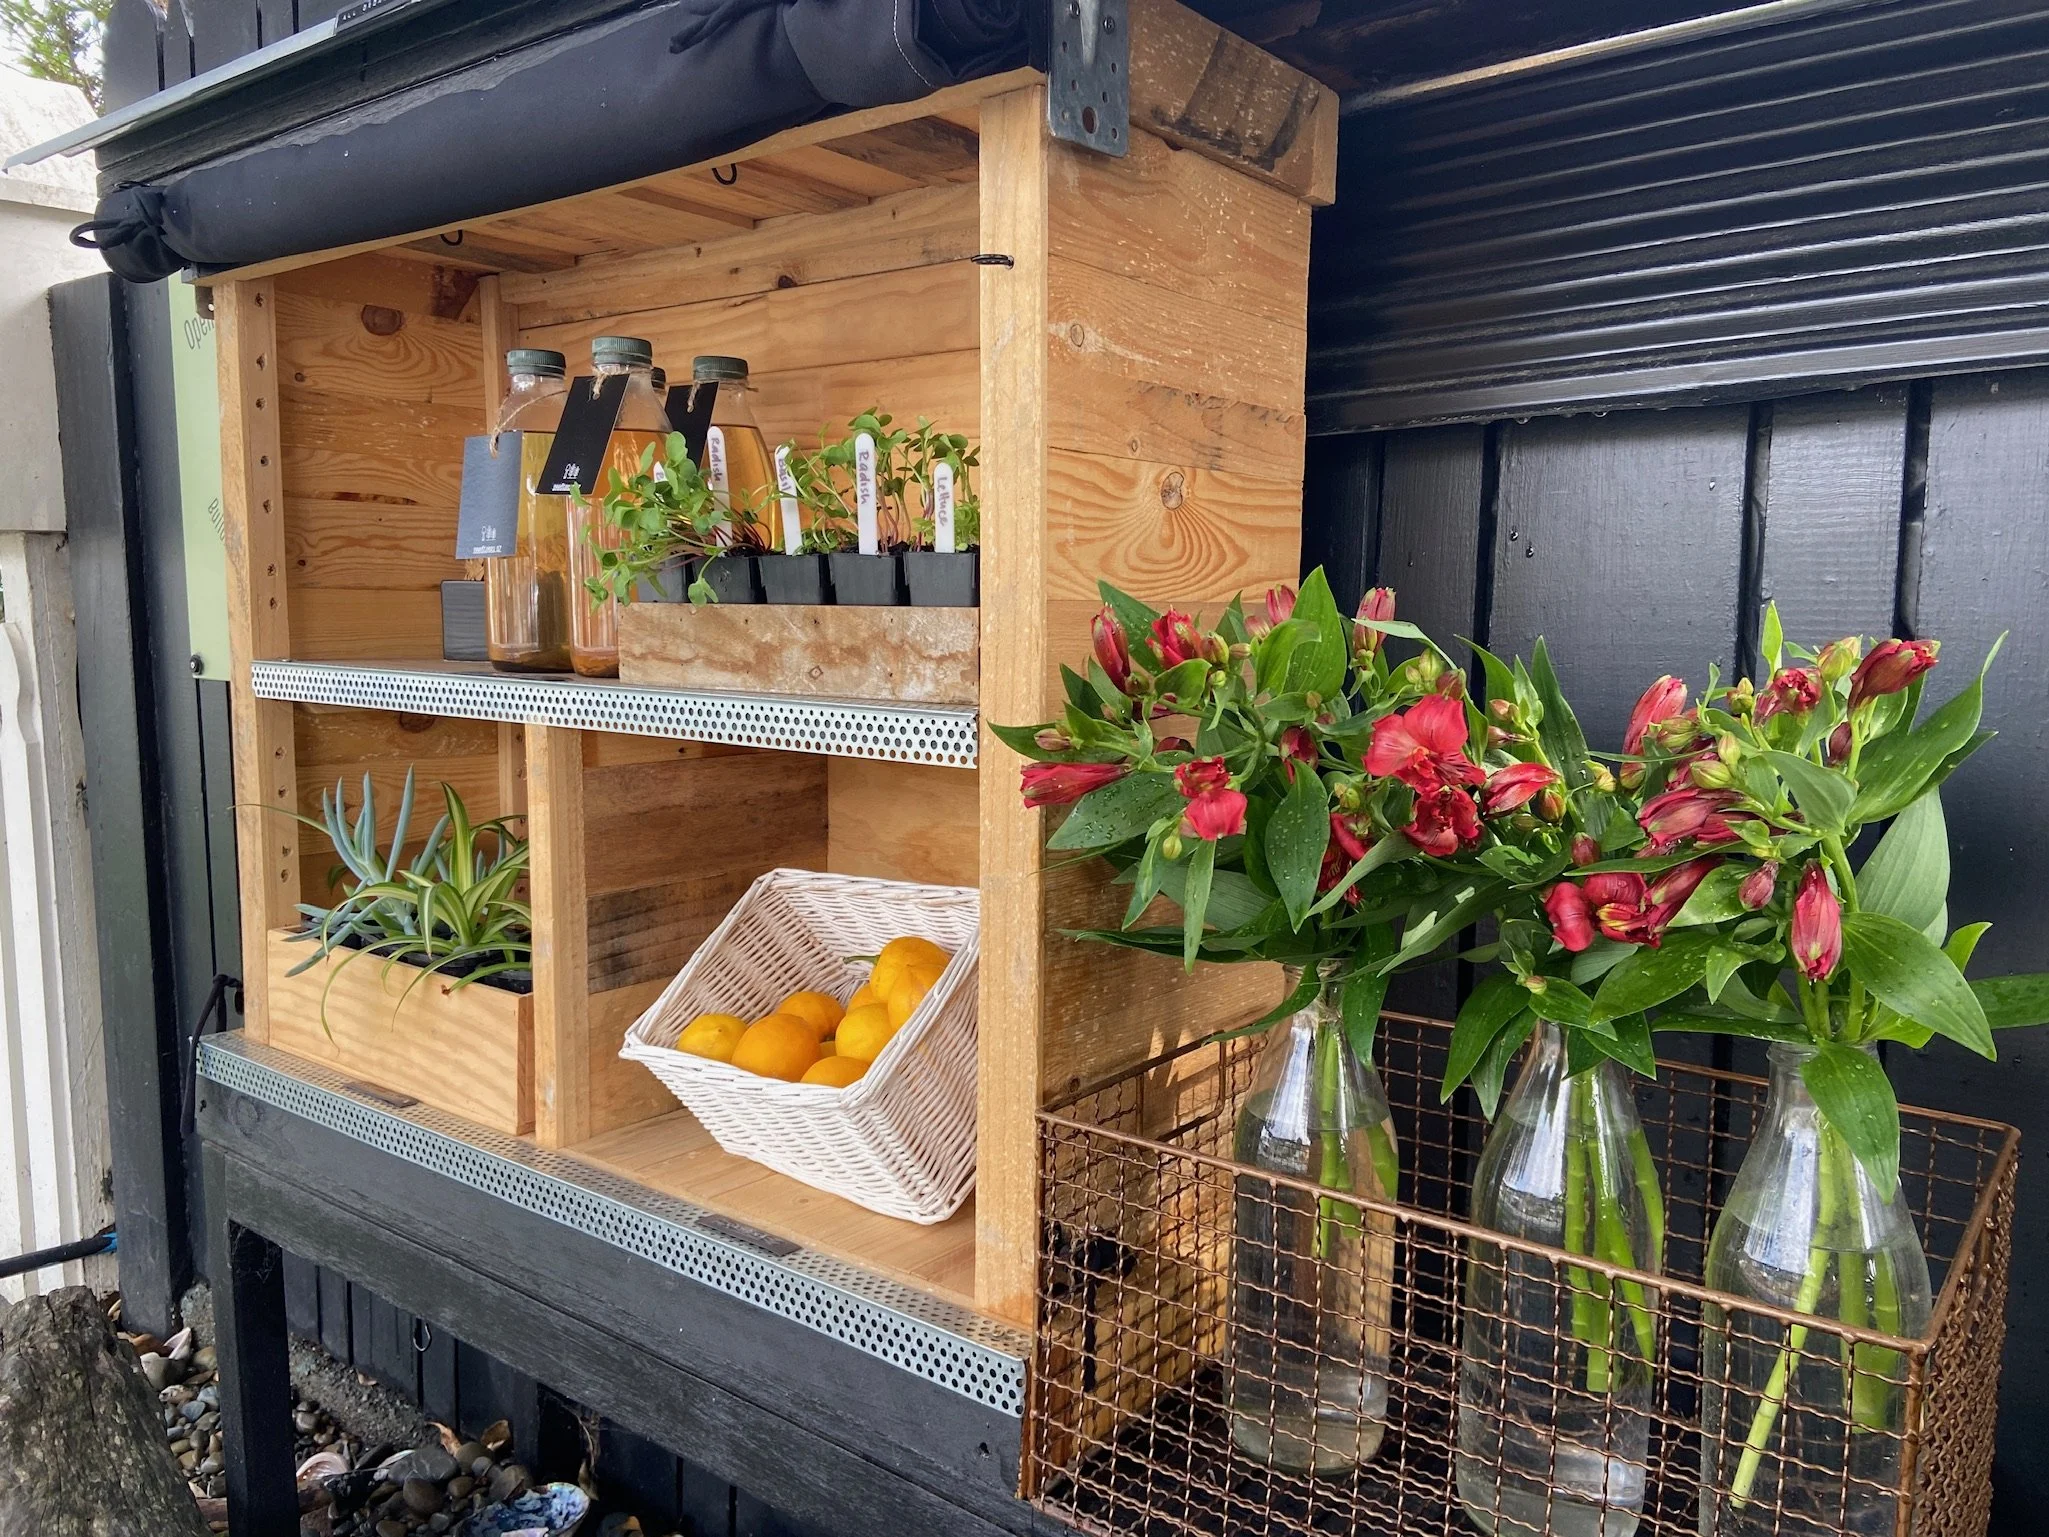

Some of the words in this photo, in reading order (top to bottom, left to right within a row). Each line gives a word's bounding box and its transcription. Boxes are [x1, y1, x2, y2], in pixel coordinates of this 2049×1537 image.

[711, 437, 723, 482] Radish
[858, 449, 871, 505] Radish
[936, 476, 951, 527] Lettuce
